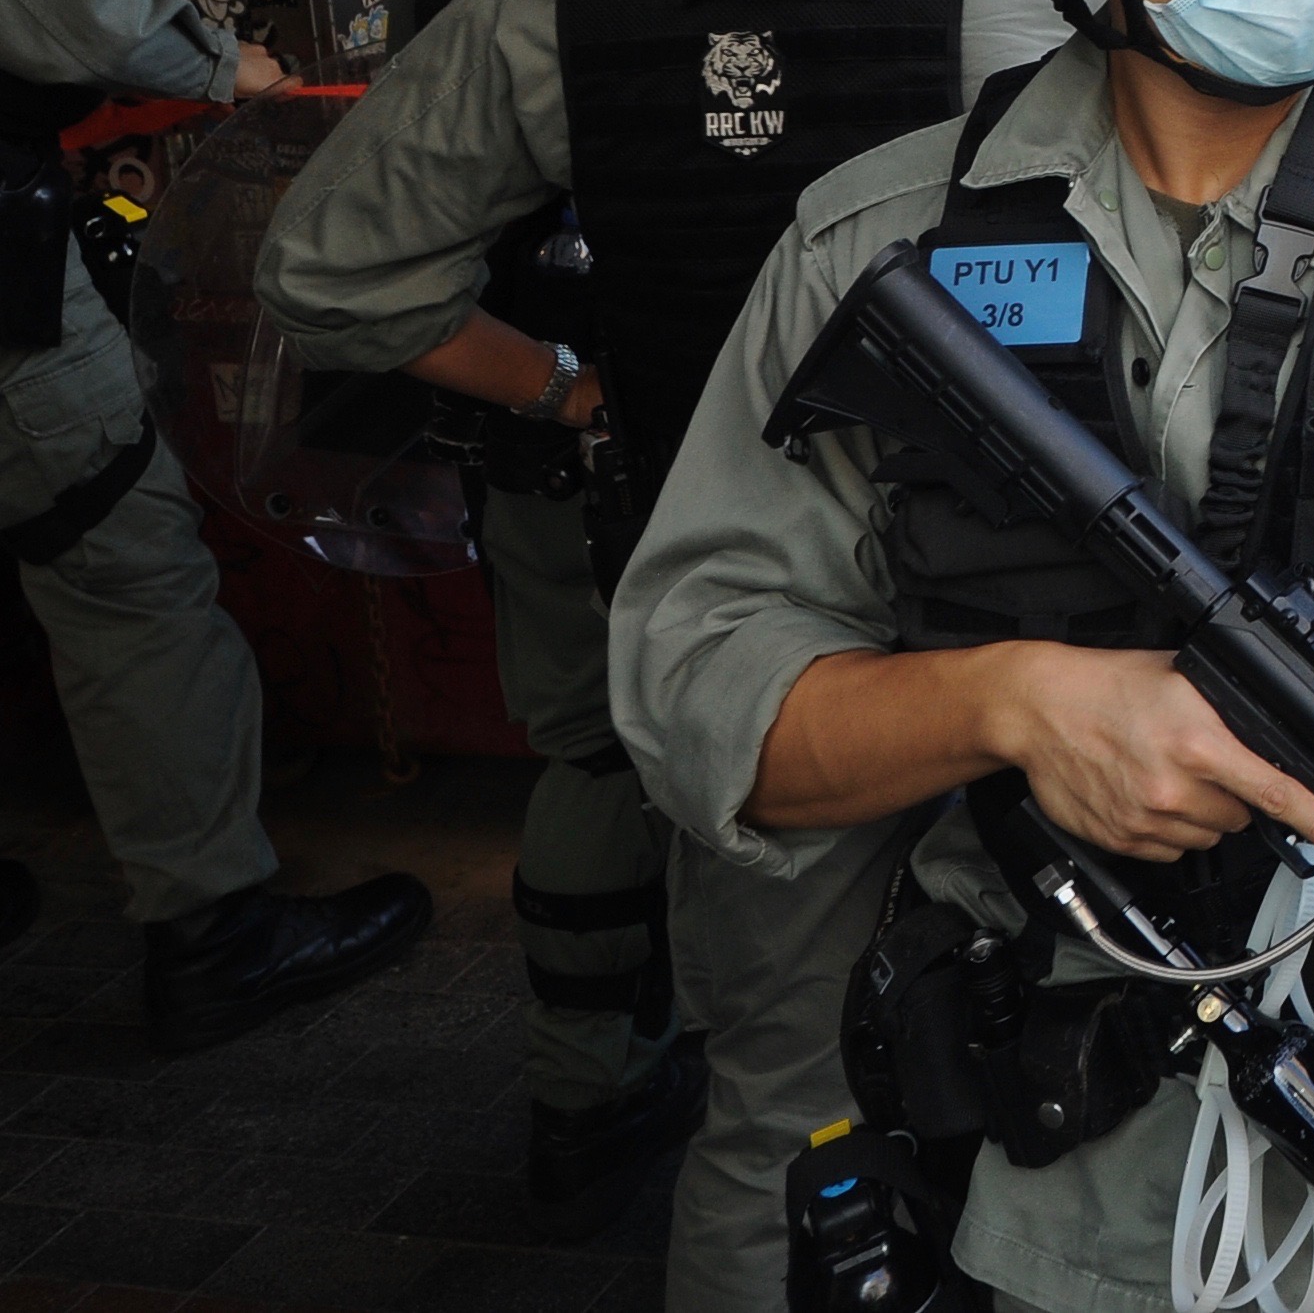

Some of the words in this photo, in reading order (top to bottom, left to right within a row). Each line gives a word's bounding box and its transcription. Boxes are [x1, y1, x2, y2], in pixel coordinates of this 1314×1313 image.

[705, 112, 745, 137] RRC
[751, 111, 784, 136] KW
[954, 259, 1015, 286] PTU
[1023, 257, 1060, 284] Y1
[980, 302, 1024, 329] 3/8
